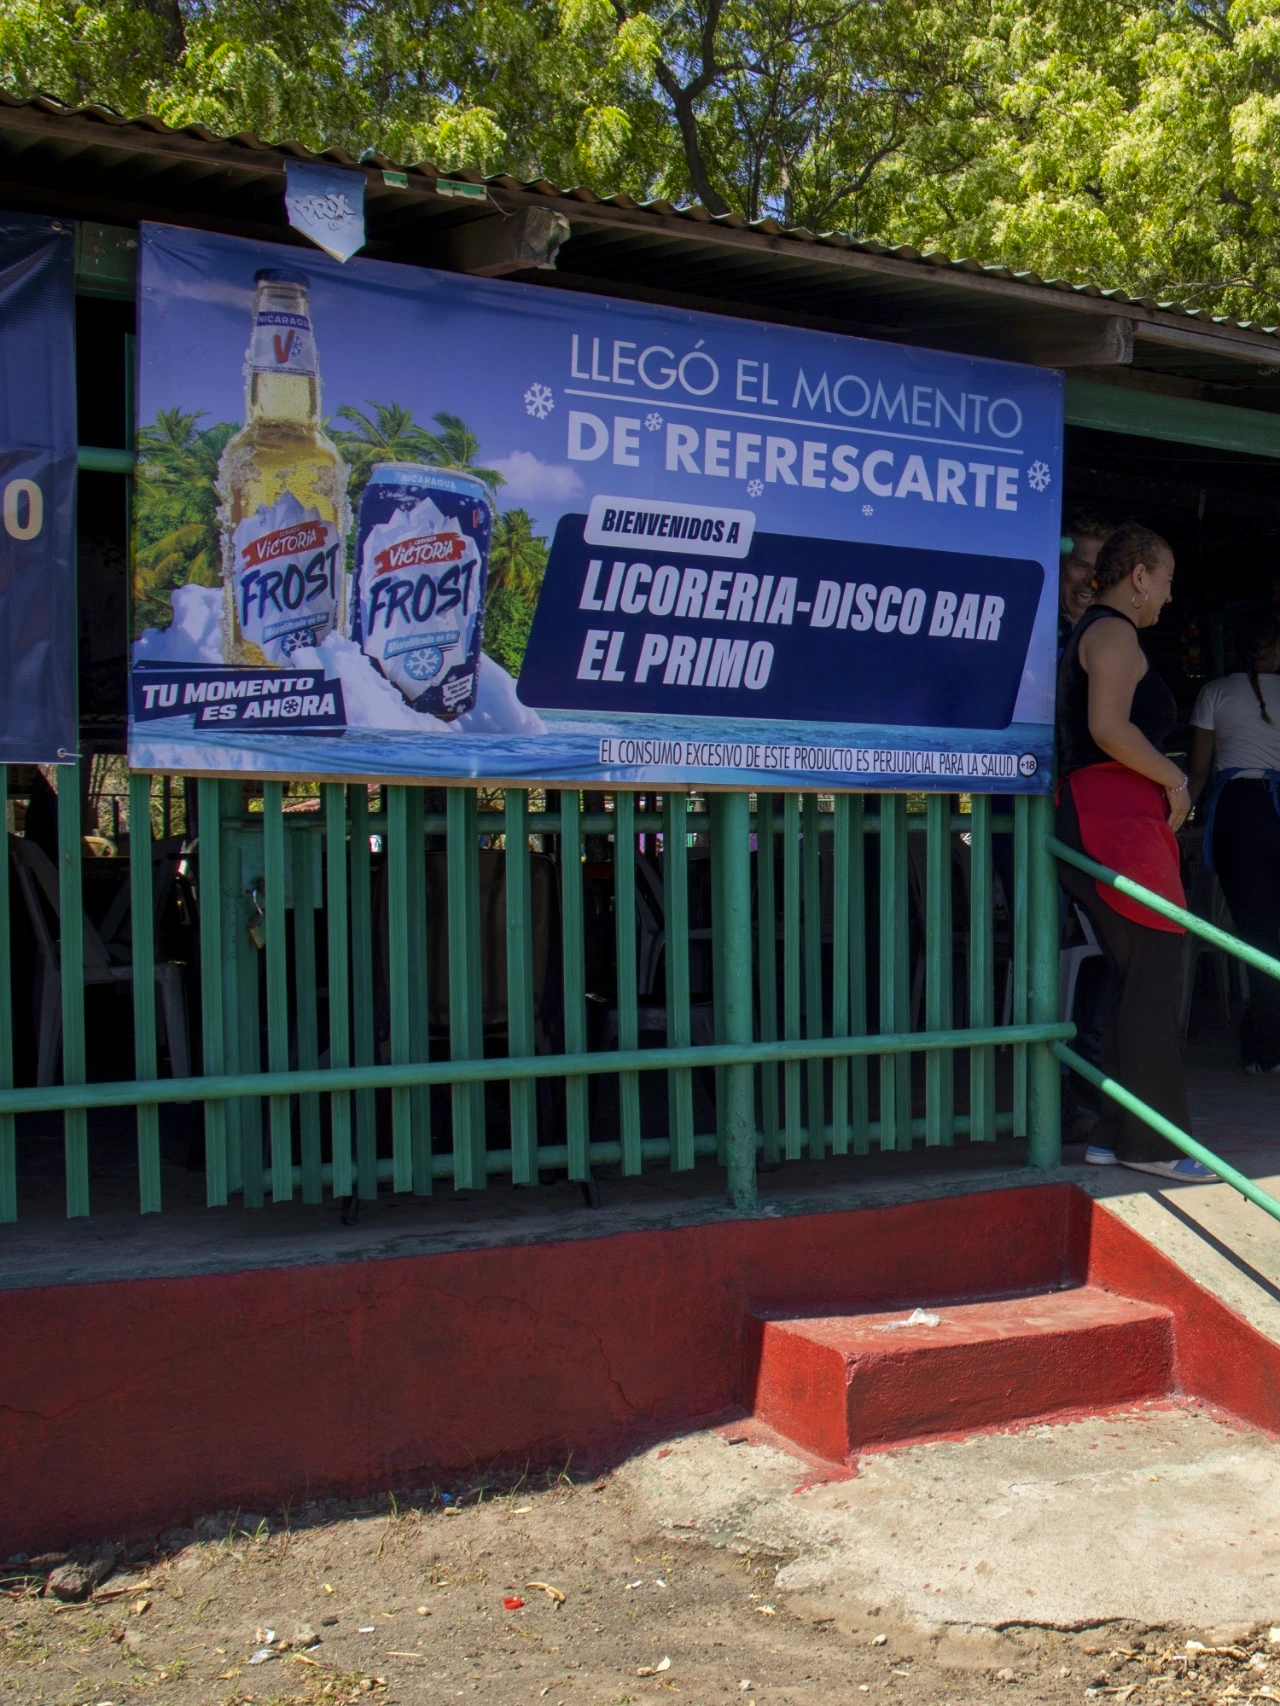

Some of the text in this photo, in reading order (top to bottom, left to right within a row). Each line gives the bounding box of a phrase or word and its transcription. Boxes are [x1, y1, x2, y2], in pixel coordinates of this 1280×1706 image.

[571, 334, 1023, 438] LLEGÓ EL MOMENTO
[402, 474, 457, 490] NICARAGUA
[566, 410, 1020, 512] DE REFRESCARTE
[601, 508, 740, 545] BIENVENIDOS A
[240, 543, 340, 626] FROST
[368, 559, 478, 635] FROST
[579, 559, 1006, 641] LICORERIA-DISCO BAR
[577, 630, 775, 690] EL PRIMO
[143, 677, 315, 709] TU MOMENTO
[202, 693, 336, 721] ES AHORA
[601, 739, 615, 763] EL
[618, 740, 682, 765] CONSUMO
[686, 743, 742, 767] EXCESIVO
[746, 745, 761, 768] DE
[764, 746, 790, 769] ESTE
[794, 747, 852, 771] PRODUCTO
[856, 750, 870, 772] ES
[873, 750, 937, 774] PERJUDICIAL
[939, 752, 964, 775] PARA
[967, 754, 979, 775] LA
[1020, 760, 1035, 771] +18
